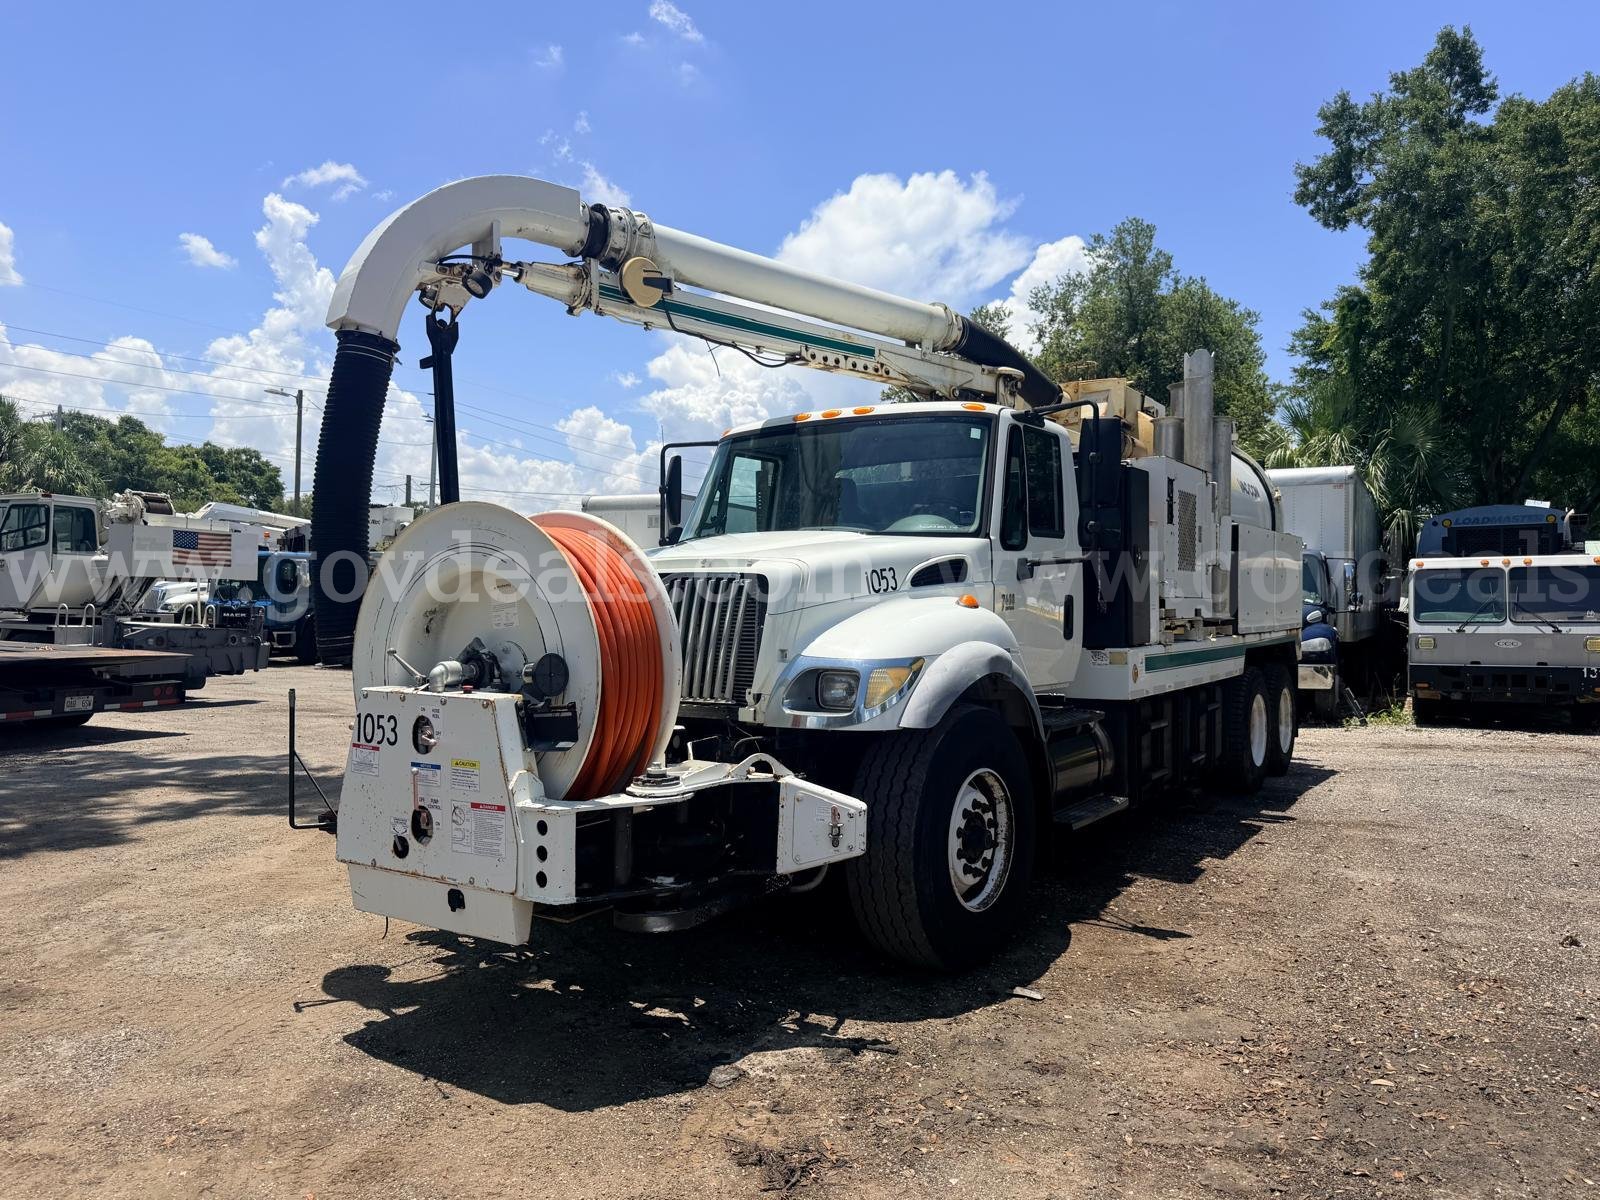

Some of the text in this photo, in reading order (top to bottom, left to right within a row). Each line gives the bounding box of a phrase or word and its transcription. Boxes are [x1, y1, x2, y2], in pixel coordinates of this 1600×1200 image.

[1582, 667, 1600, 679] 13
[357, 712, 398, 746] 1053
[459, 760, 477, 768] CAUTION
